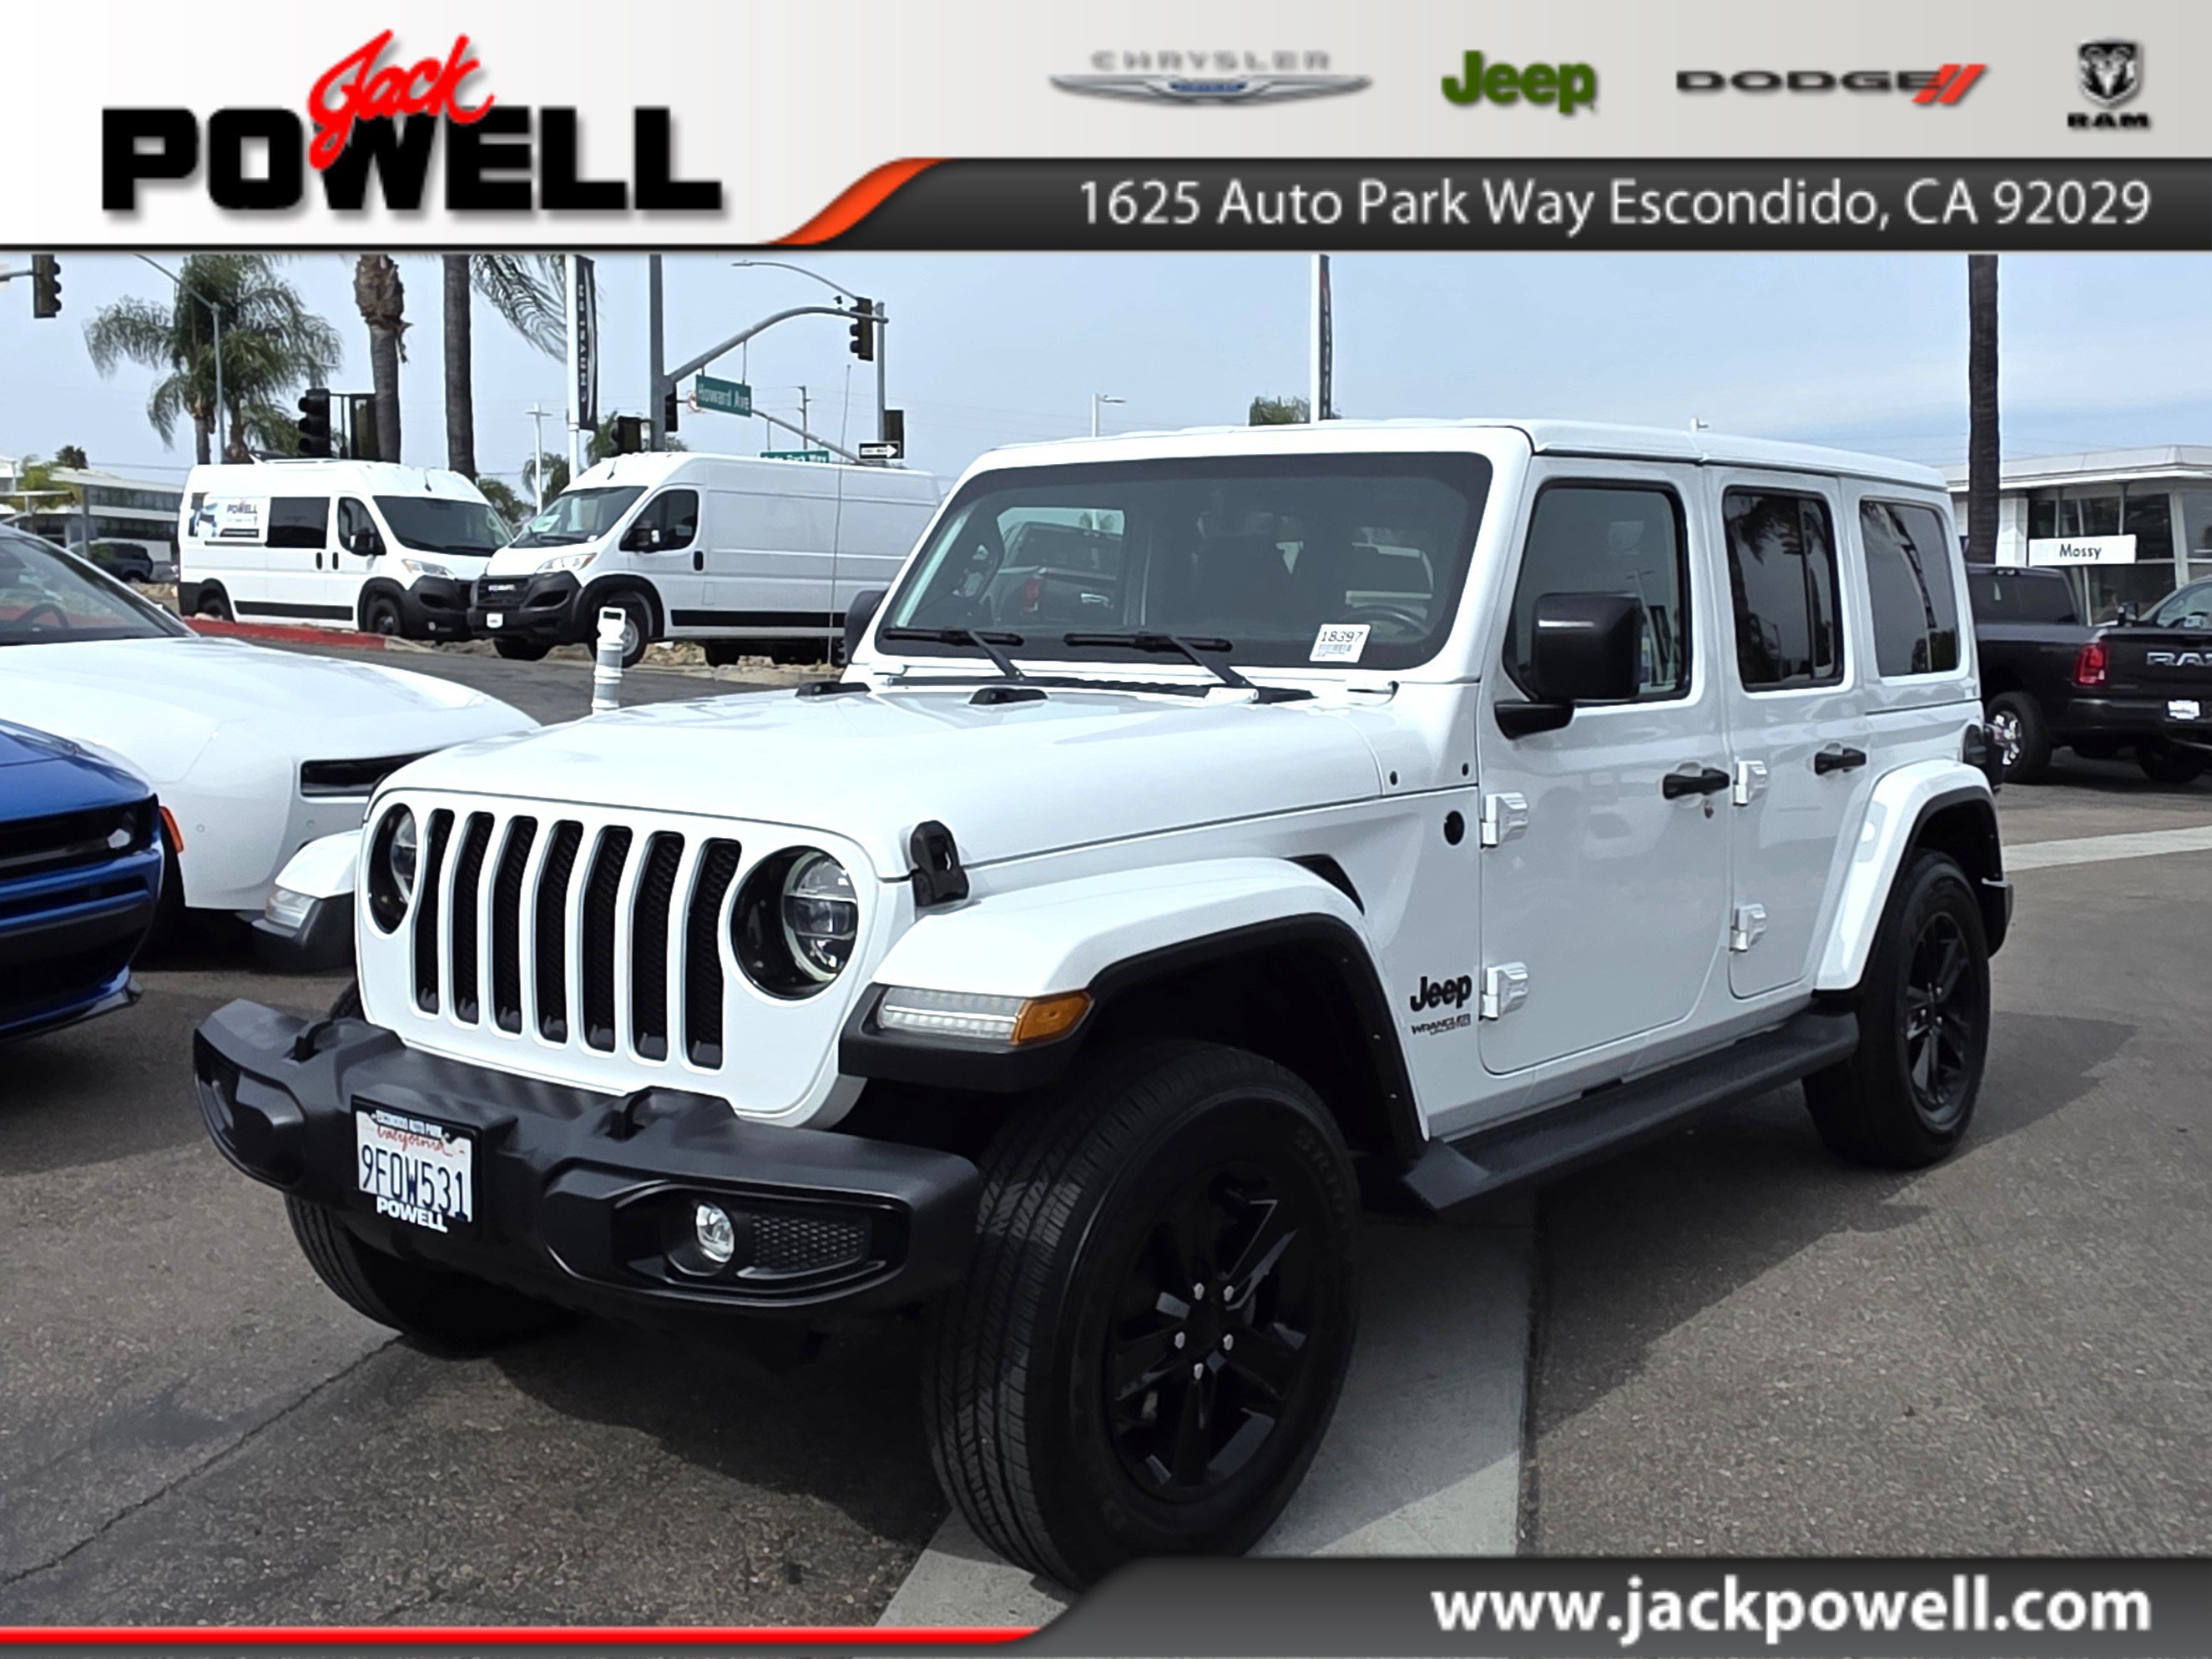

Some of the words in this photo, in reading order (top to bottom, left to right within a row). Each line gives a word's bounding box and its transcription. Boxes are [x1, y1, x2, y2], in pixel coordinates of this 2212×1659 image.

[698, 383, 731, 407] Howard
[734, 390, 749, 411] Ave
[2059, 543, 2102, 560] Mossy
[1321, 630, 1364, 643] 18397
[1410, 975, 1472, 1011] Jeep
[376, 1195, 448, 1233] POWELL
